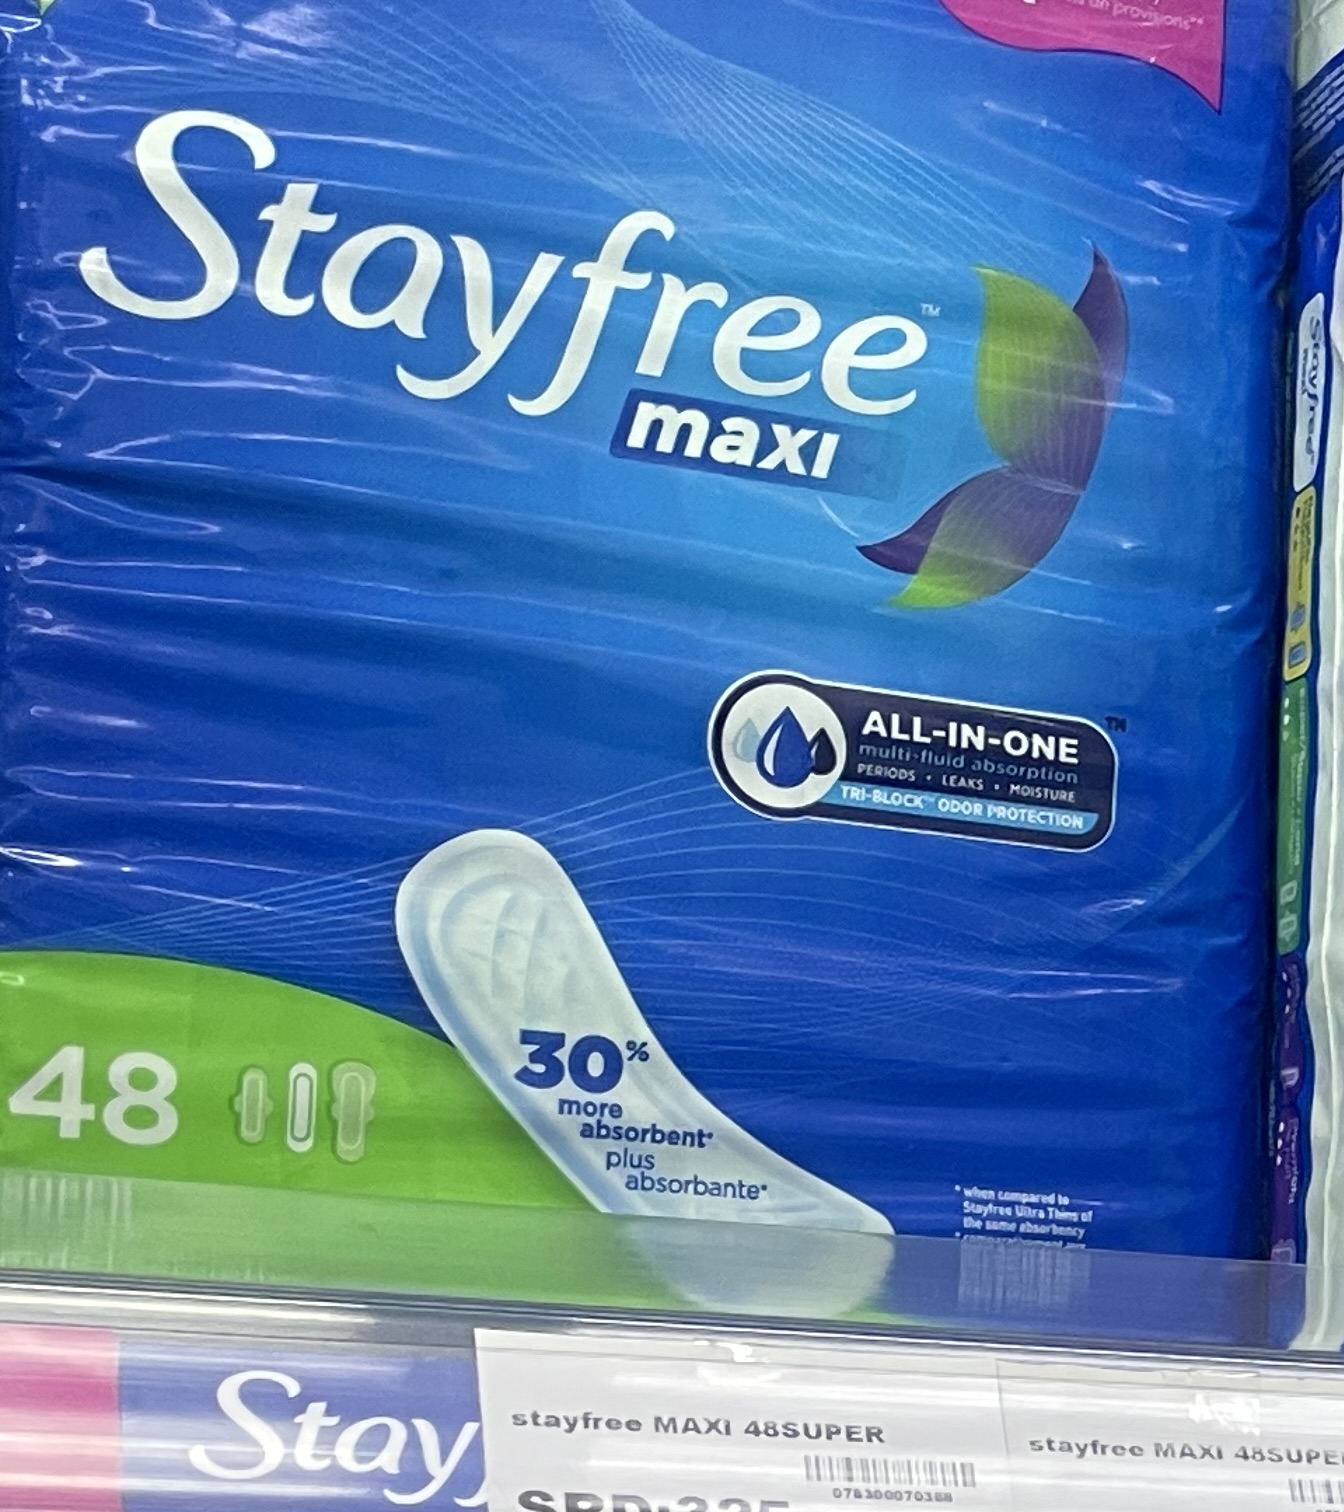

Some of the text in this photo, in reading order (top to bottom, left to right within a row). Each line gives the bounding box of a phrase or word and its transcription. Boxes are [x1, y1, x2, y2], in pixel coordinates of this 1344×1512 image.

[79, 109, 930, 417] Stayfree
[627, 398, 840, 482] maxi
[862, 709, 1080, 765] ALL-IN-ONE
[858, 743, 1079, 785] multi-fluid absorption
[857, 763, 1077, 804] PERIODS LEAKS MOISTURE
[938, 798, 983, 817] ODOR
[987, 805, 1084, 830] PROTECTION
[514, 1029, 650, 1094] 30%
[8, 1045, 180, 1146] 48
[558, 1098, 623, 1119] more
[580, 1119, 707, 1149] absorbent
[606, 1149, 655, 1171] plus
[625, 1172, 760, 1200] absorbante
[512, 1411, 886, 1444] stayfree MAXI 48SUPER
[1029, 1437, 1144, 1460] stayfree
[1154, 1442, 1224, 1461] MAXI
